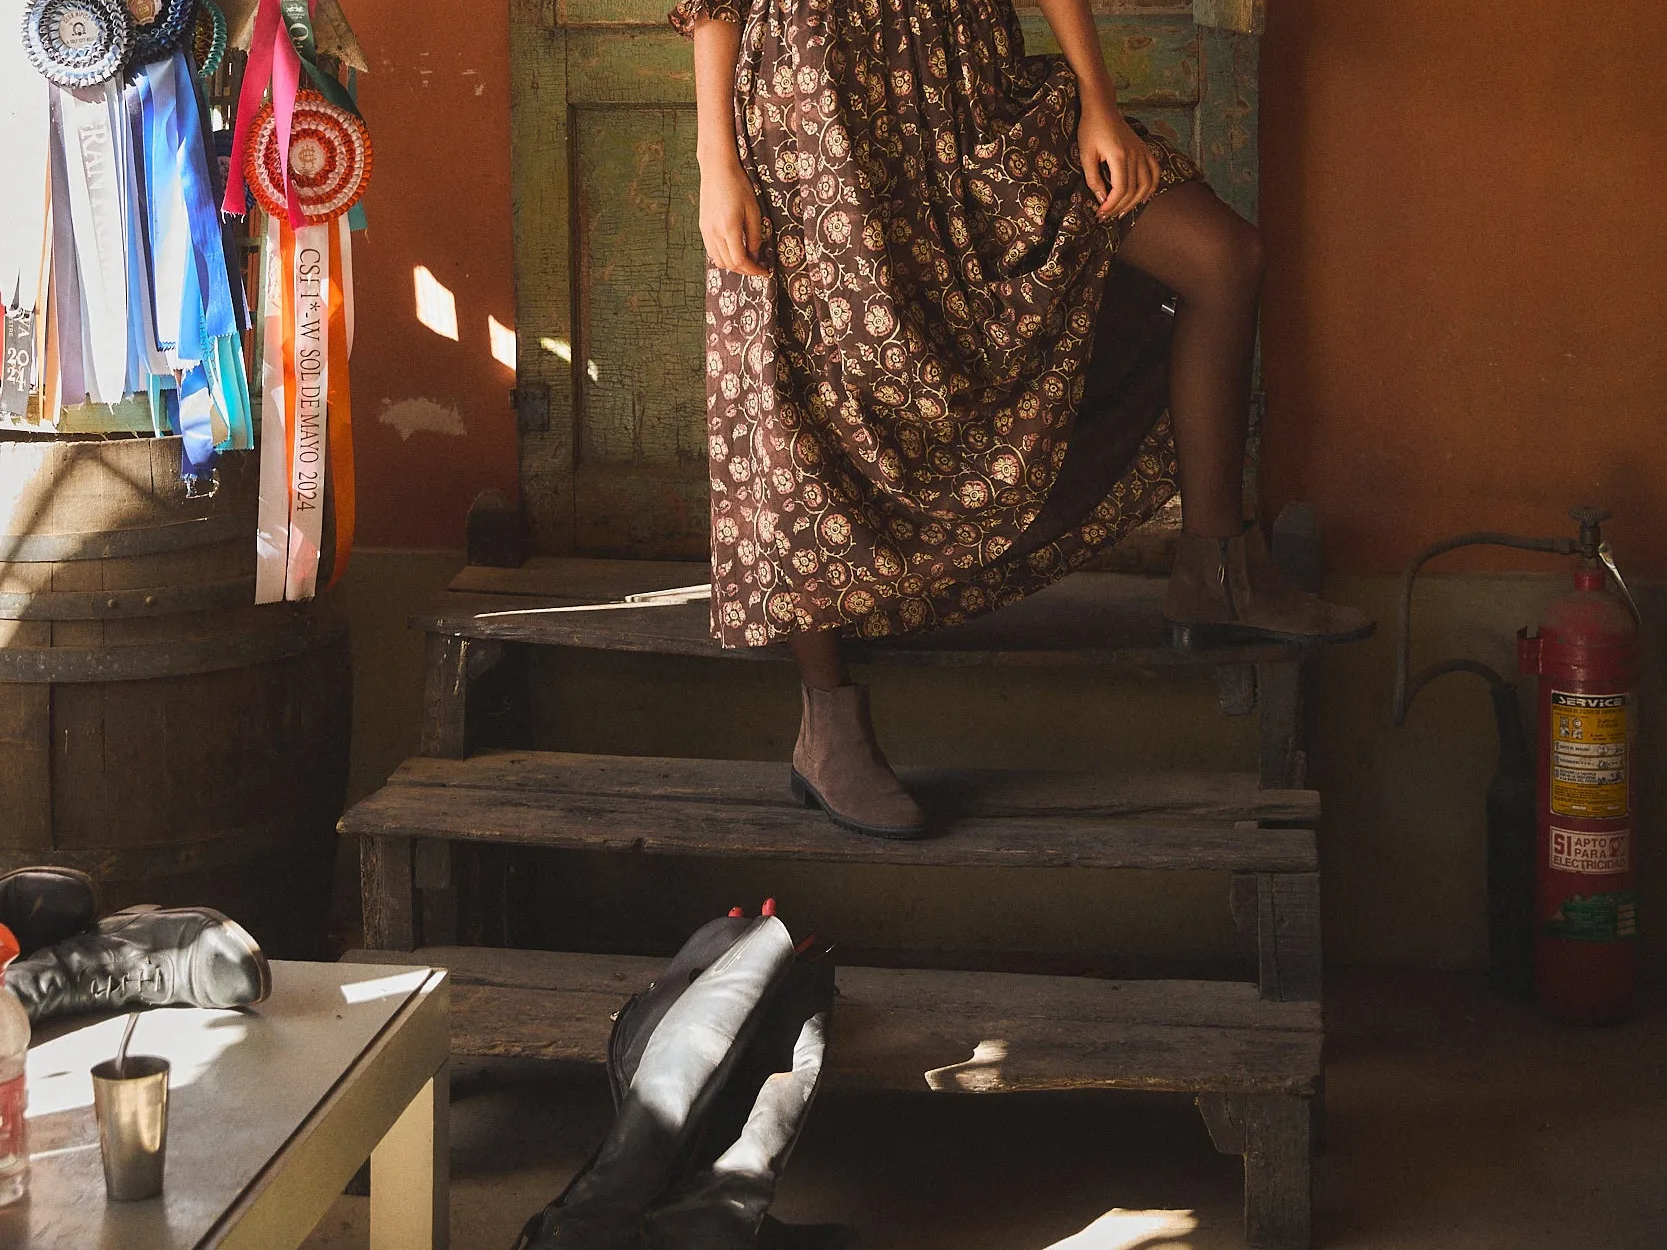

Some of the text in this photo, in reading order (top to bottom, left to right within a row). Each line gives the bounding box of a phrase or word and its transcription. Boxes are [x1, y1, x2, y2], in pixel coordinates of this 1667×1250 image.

[300, 248, 321, 284] CSI
[300, 349, 321, 381] SOL
[301, 385, 321, 409] DE
[300, 413, 320, 463] MAYO
[296, 471, 318, 512] 2024
[1554, 833, 1607, 857] SI APTO
[1574, 848, 1607, 859] PARA
[1553, 855, 1627, 870] ELECTRICIDAD
